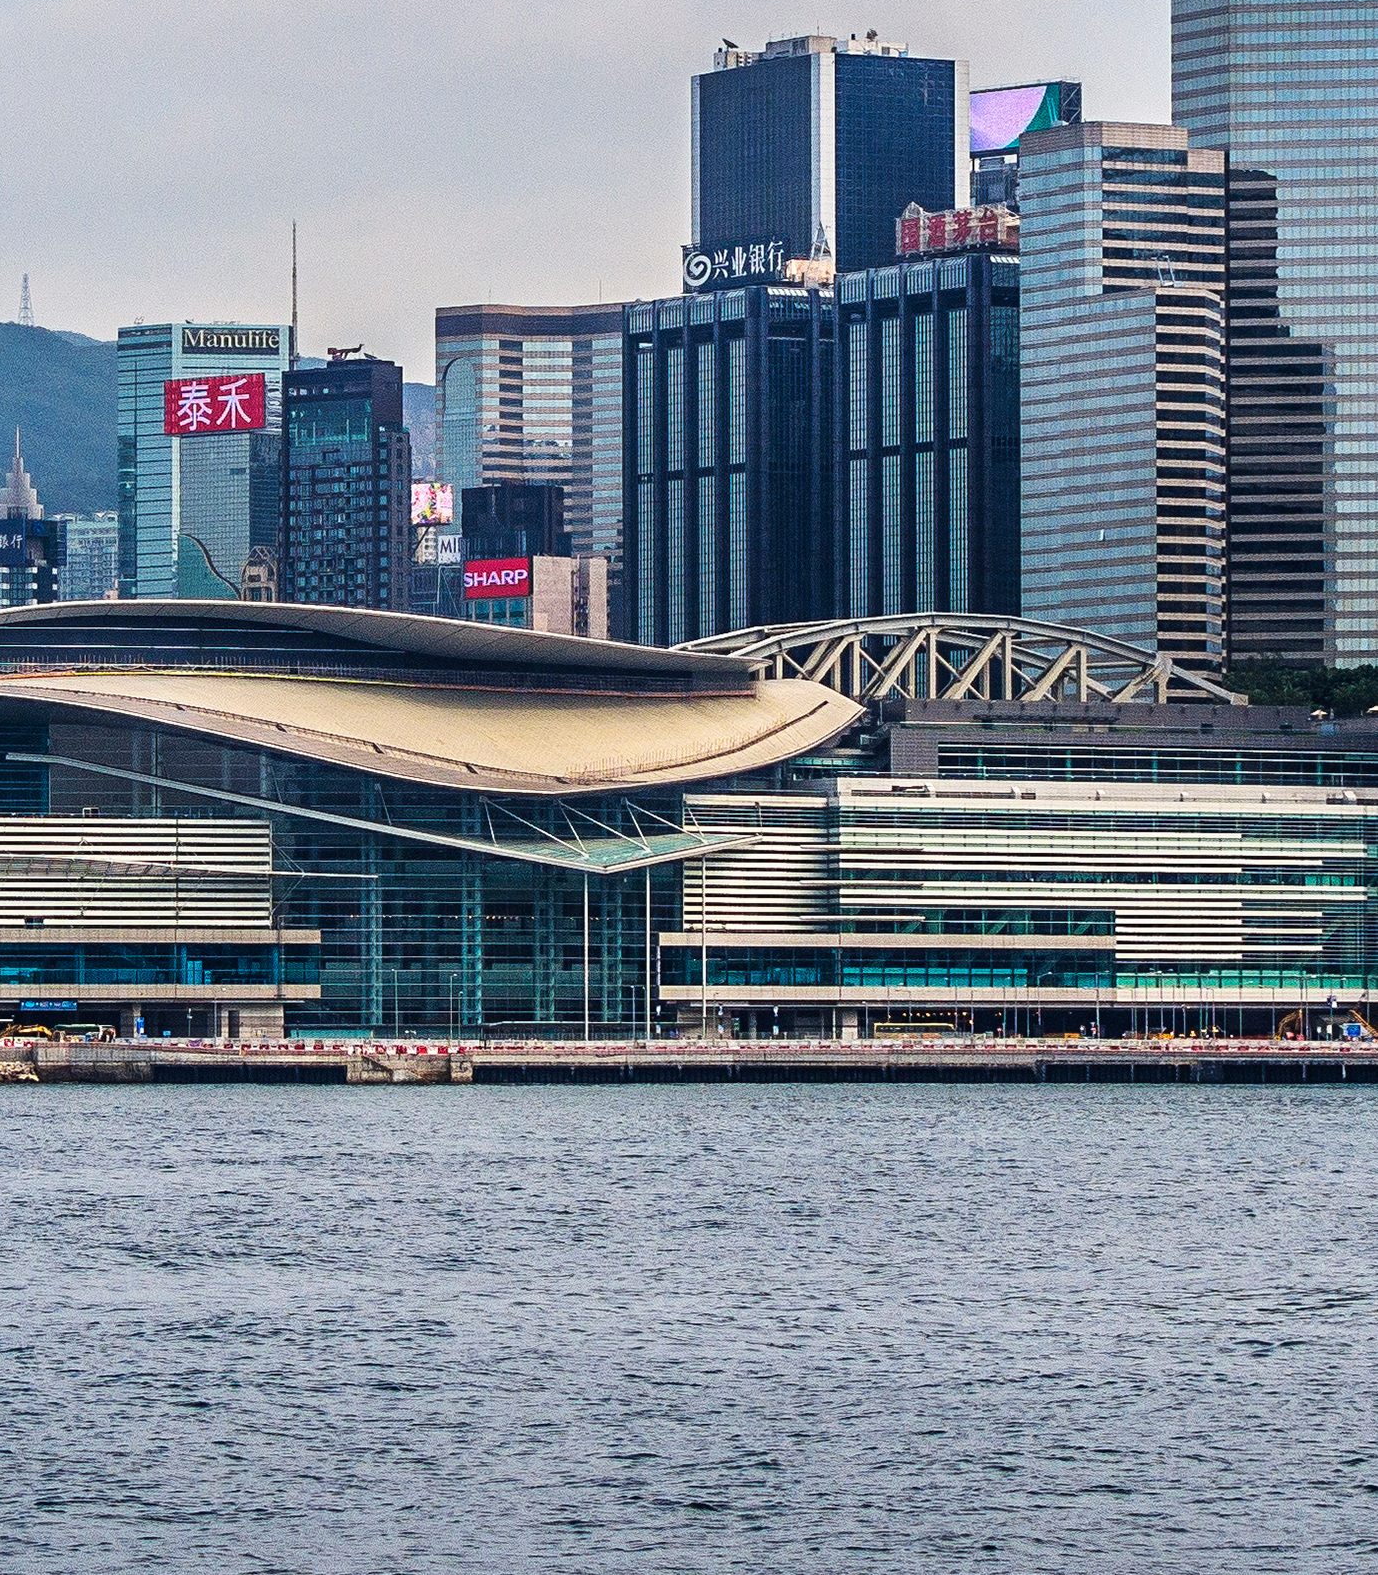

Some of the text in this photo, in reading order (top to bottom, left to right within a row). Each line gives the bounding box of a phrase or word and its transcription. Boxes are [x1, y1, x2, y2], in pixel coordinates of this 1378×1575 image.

[712, 241, 785, 280] 兴业银行
[183, 329, 279, 348] Manulife
[177, 378, 252, 431] 泰禾
[440, 537, 463, 554] MI
[463, 569, 528, 588] SHARP
